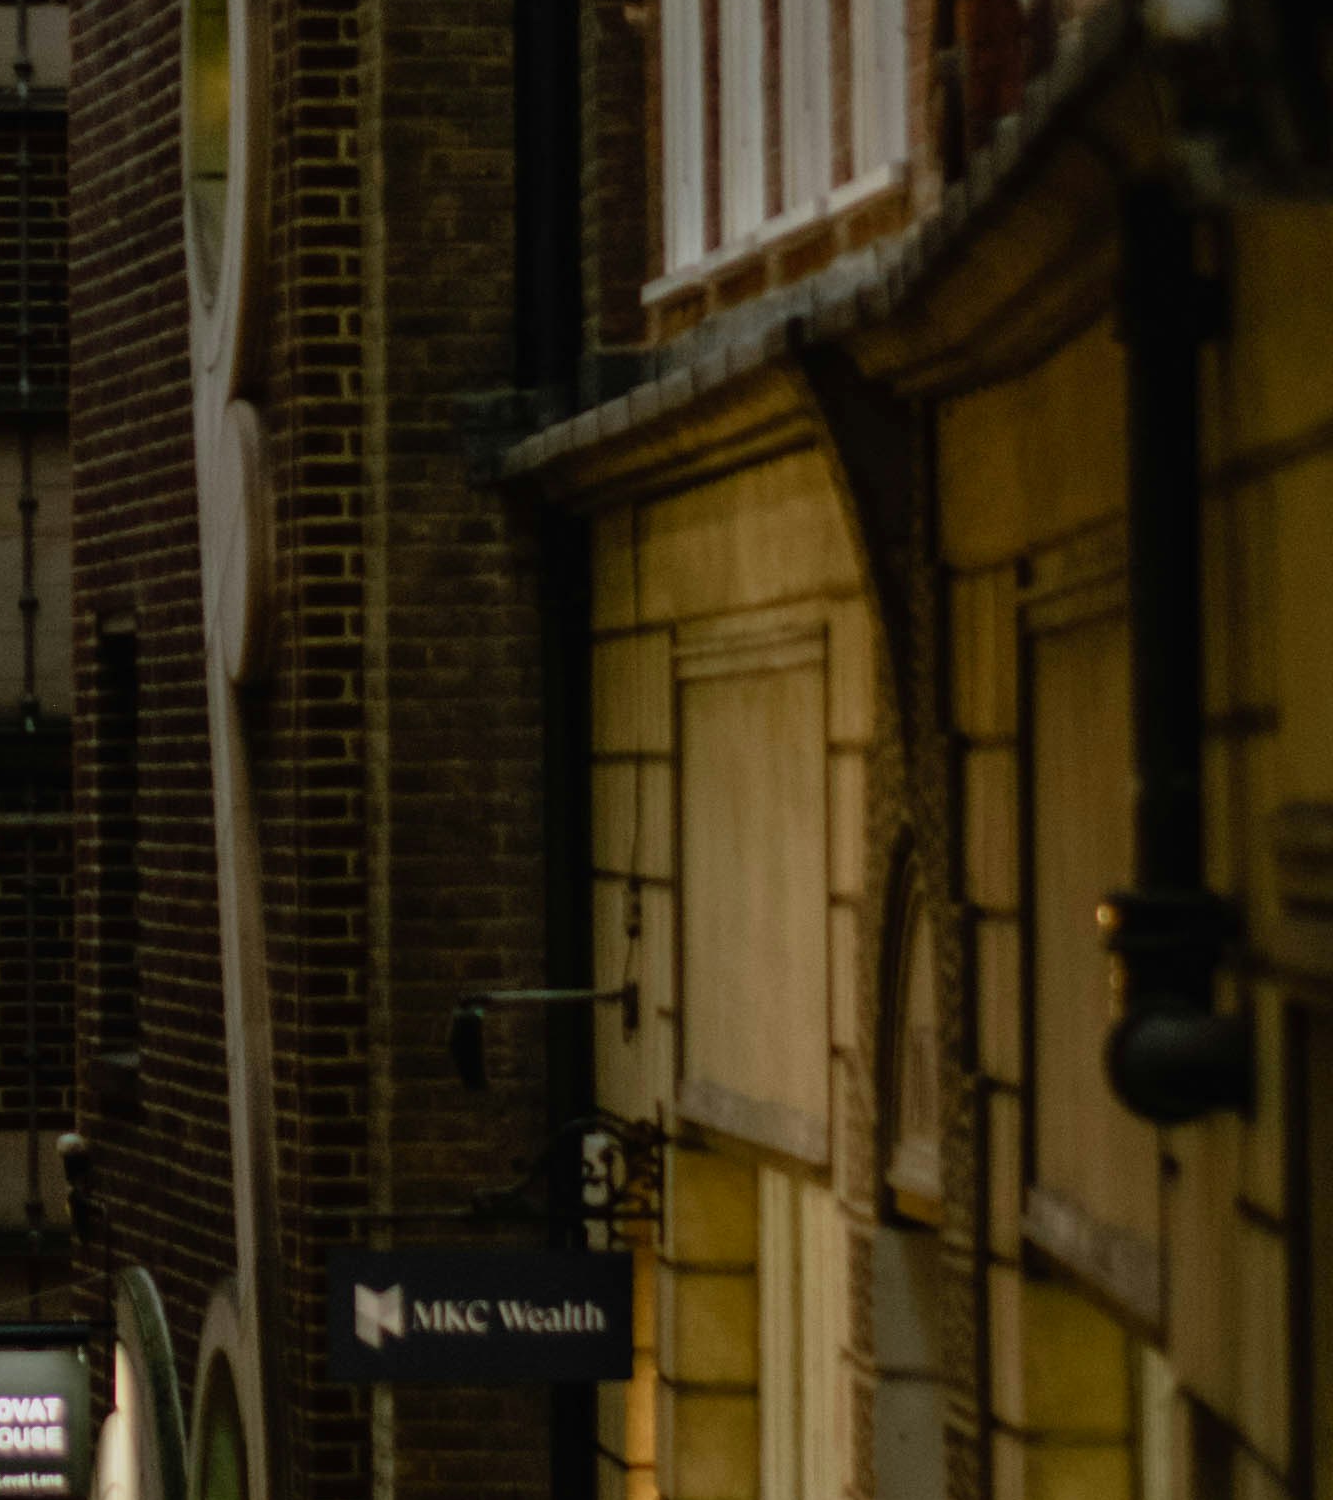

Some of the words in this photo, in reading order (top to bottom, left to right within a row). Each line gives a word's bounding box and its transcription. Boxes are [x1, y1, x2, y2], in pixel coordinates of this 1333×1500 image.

[413, 1299, 490, 1334] MKC
[498, 1299, 607, 1334] Wealth
[31, 1472, 64, 1490] Lane
